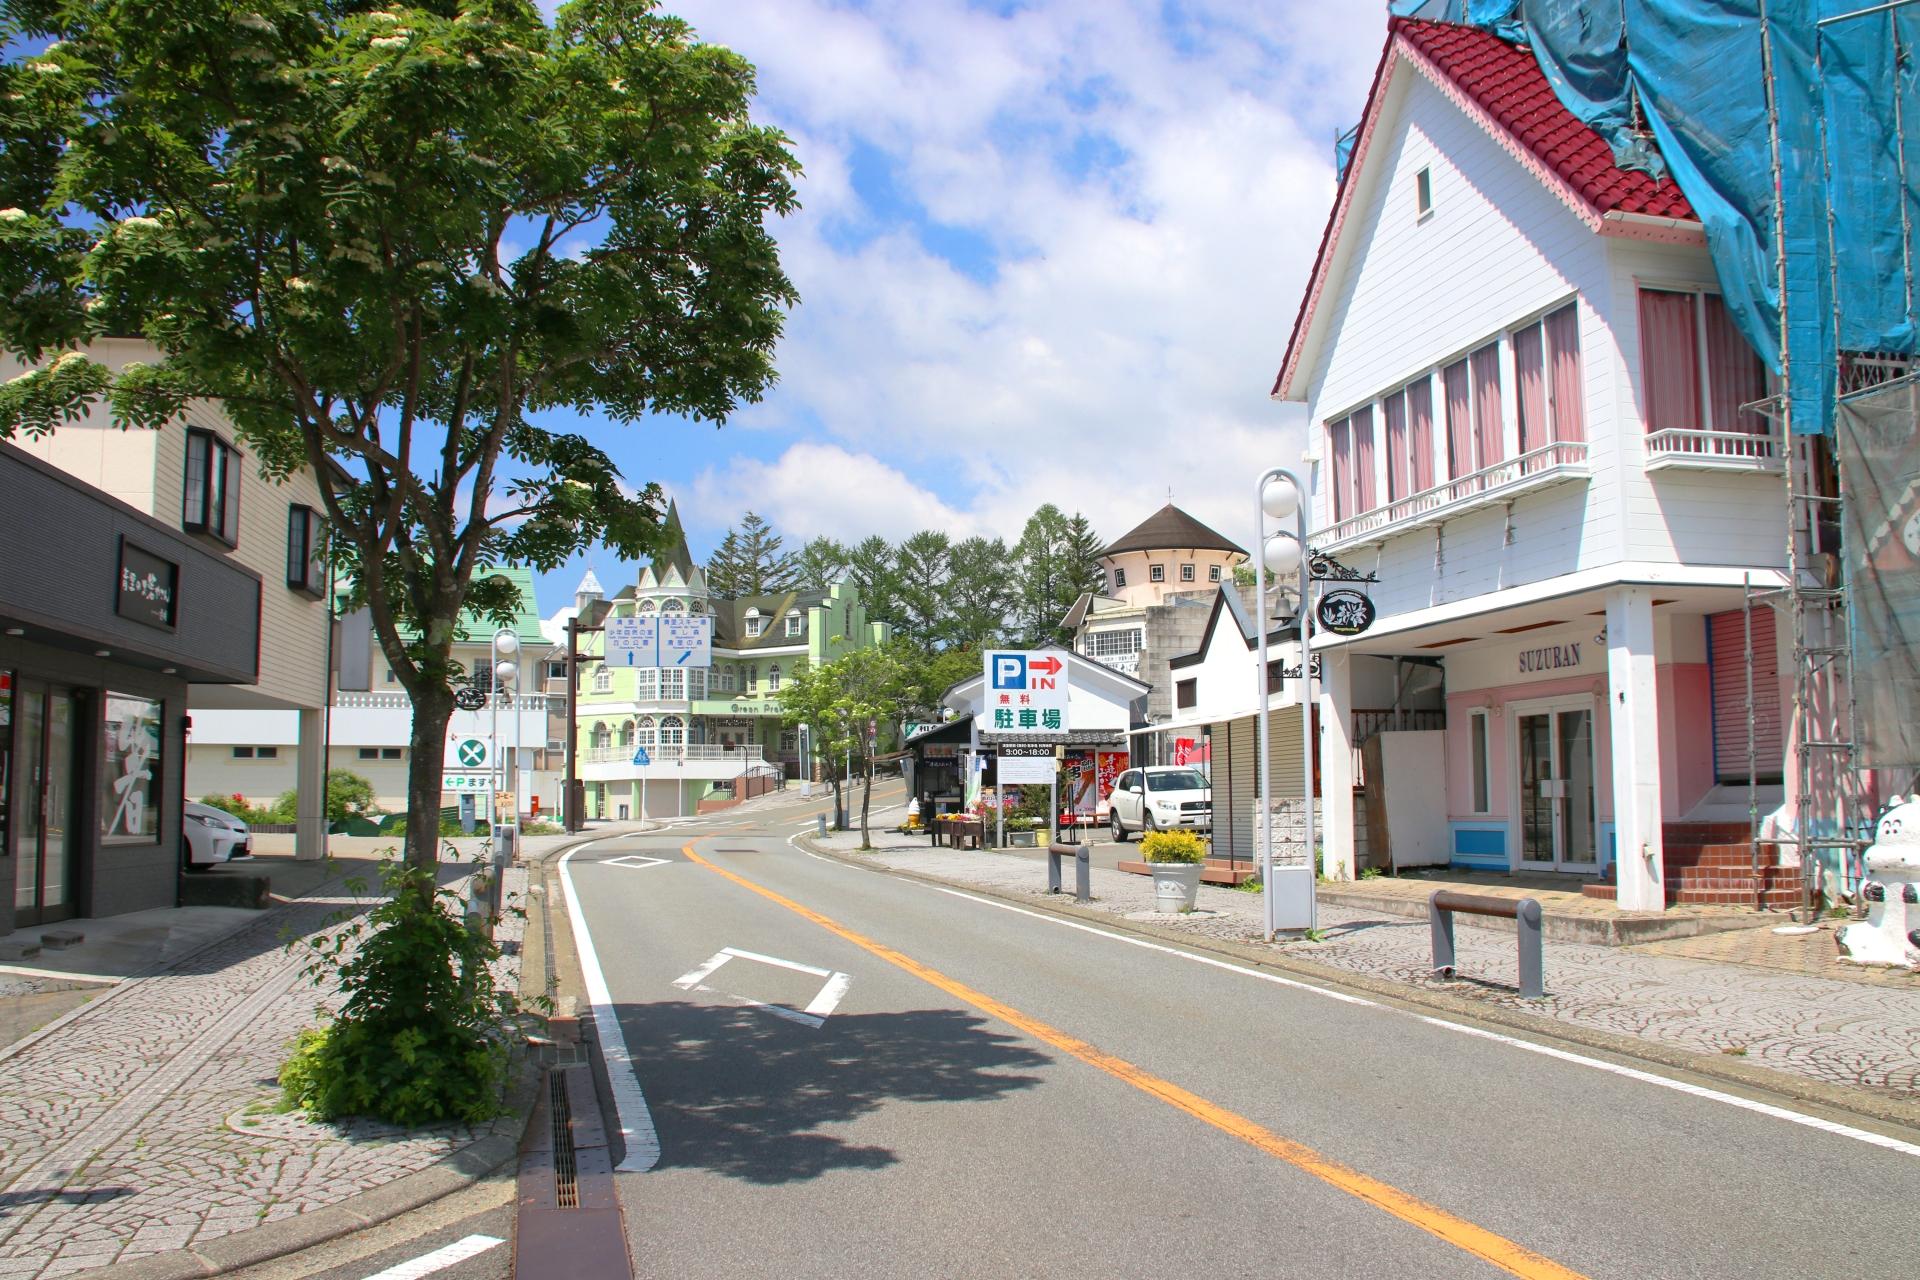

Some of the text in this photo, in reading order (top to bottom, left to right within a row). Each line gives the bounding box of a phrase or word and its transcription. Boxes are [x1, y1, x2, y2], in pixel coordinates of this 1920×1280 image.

[1519, 643, 1580, 672] SUZURAN
[998, 658, 1021, 686] P
[1031, 677, 1055, 690] IN
[999, 693, 1031, 704] 無料
[731, 703, 758, 713] Green
[994, 708, 1061, 729] 駐車場
